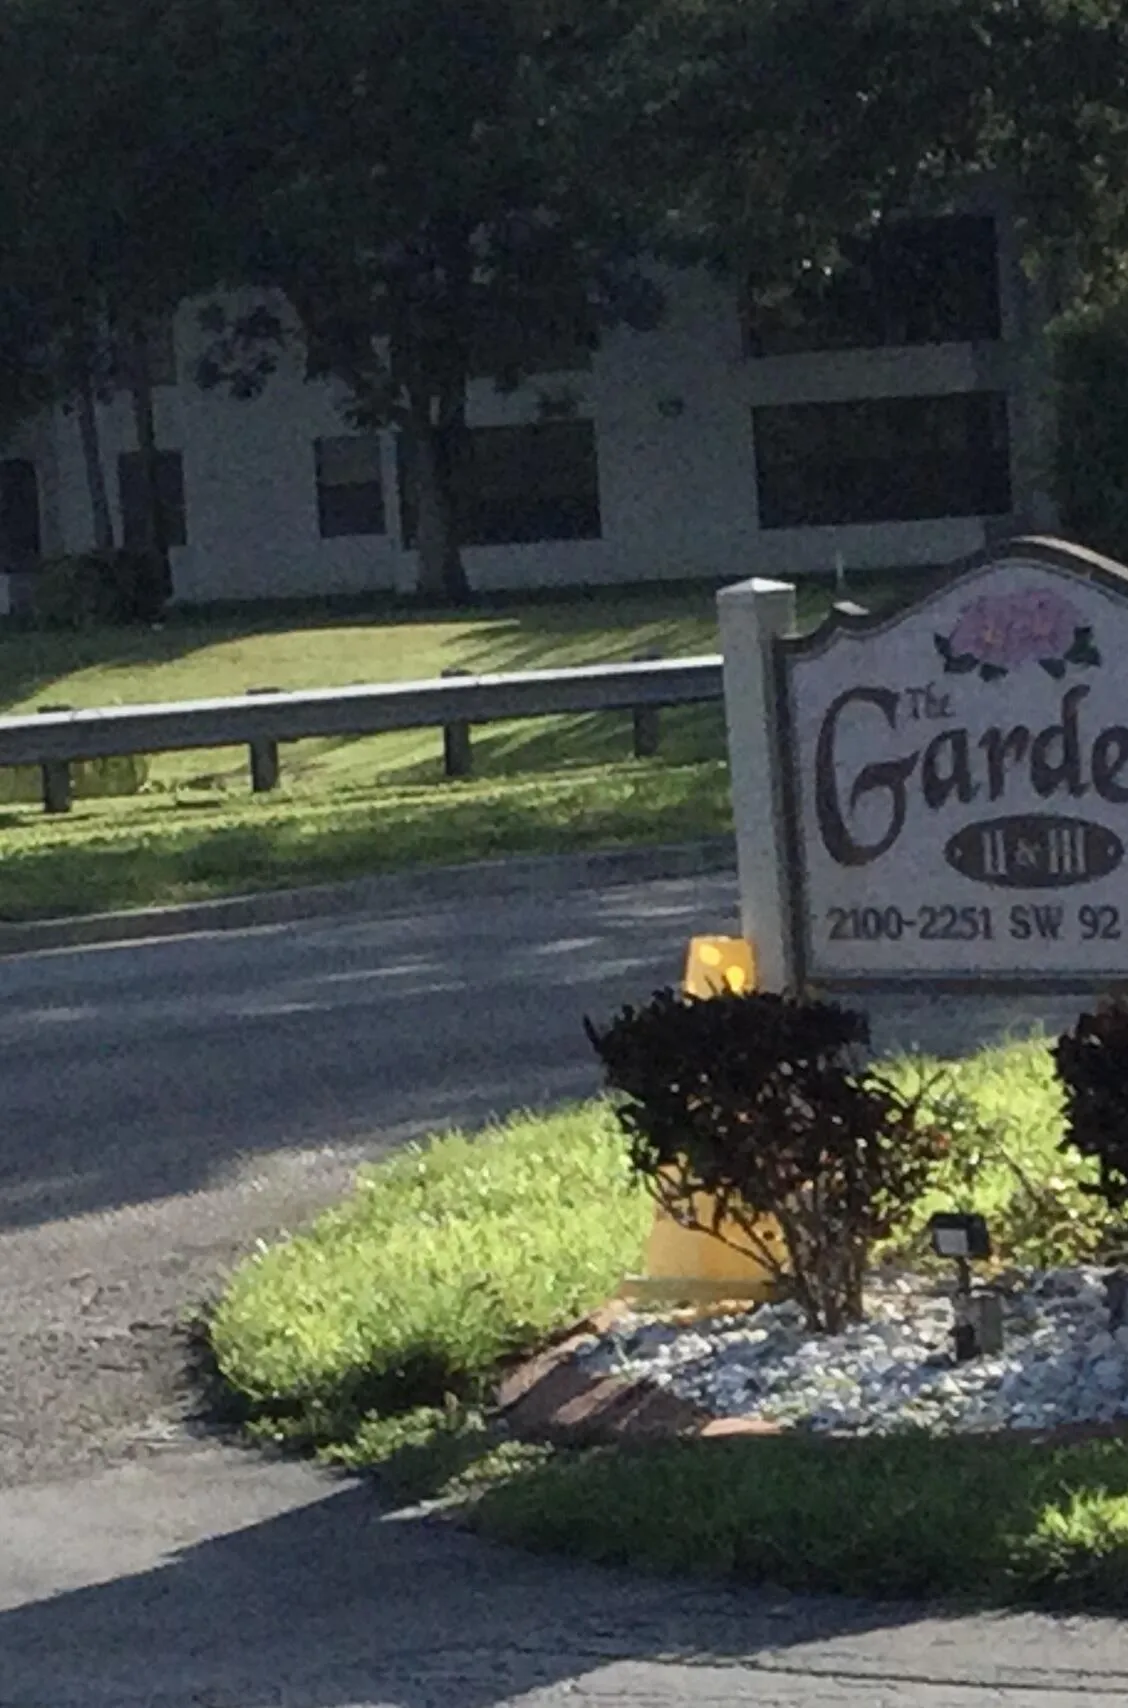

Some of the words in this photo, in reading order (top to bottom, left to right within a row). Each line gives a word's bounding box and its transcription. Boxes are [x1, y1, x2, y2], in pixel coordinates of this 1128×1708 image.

[905, 682, 952, 718] The
[828, 906, 993, 940] 2100-2251
[1009, 906, 1062, 939] SW
[1078, 906, 1122, 939] 92
